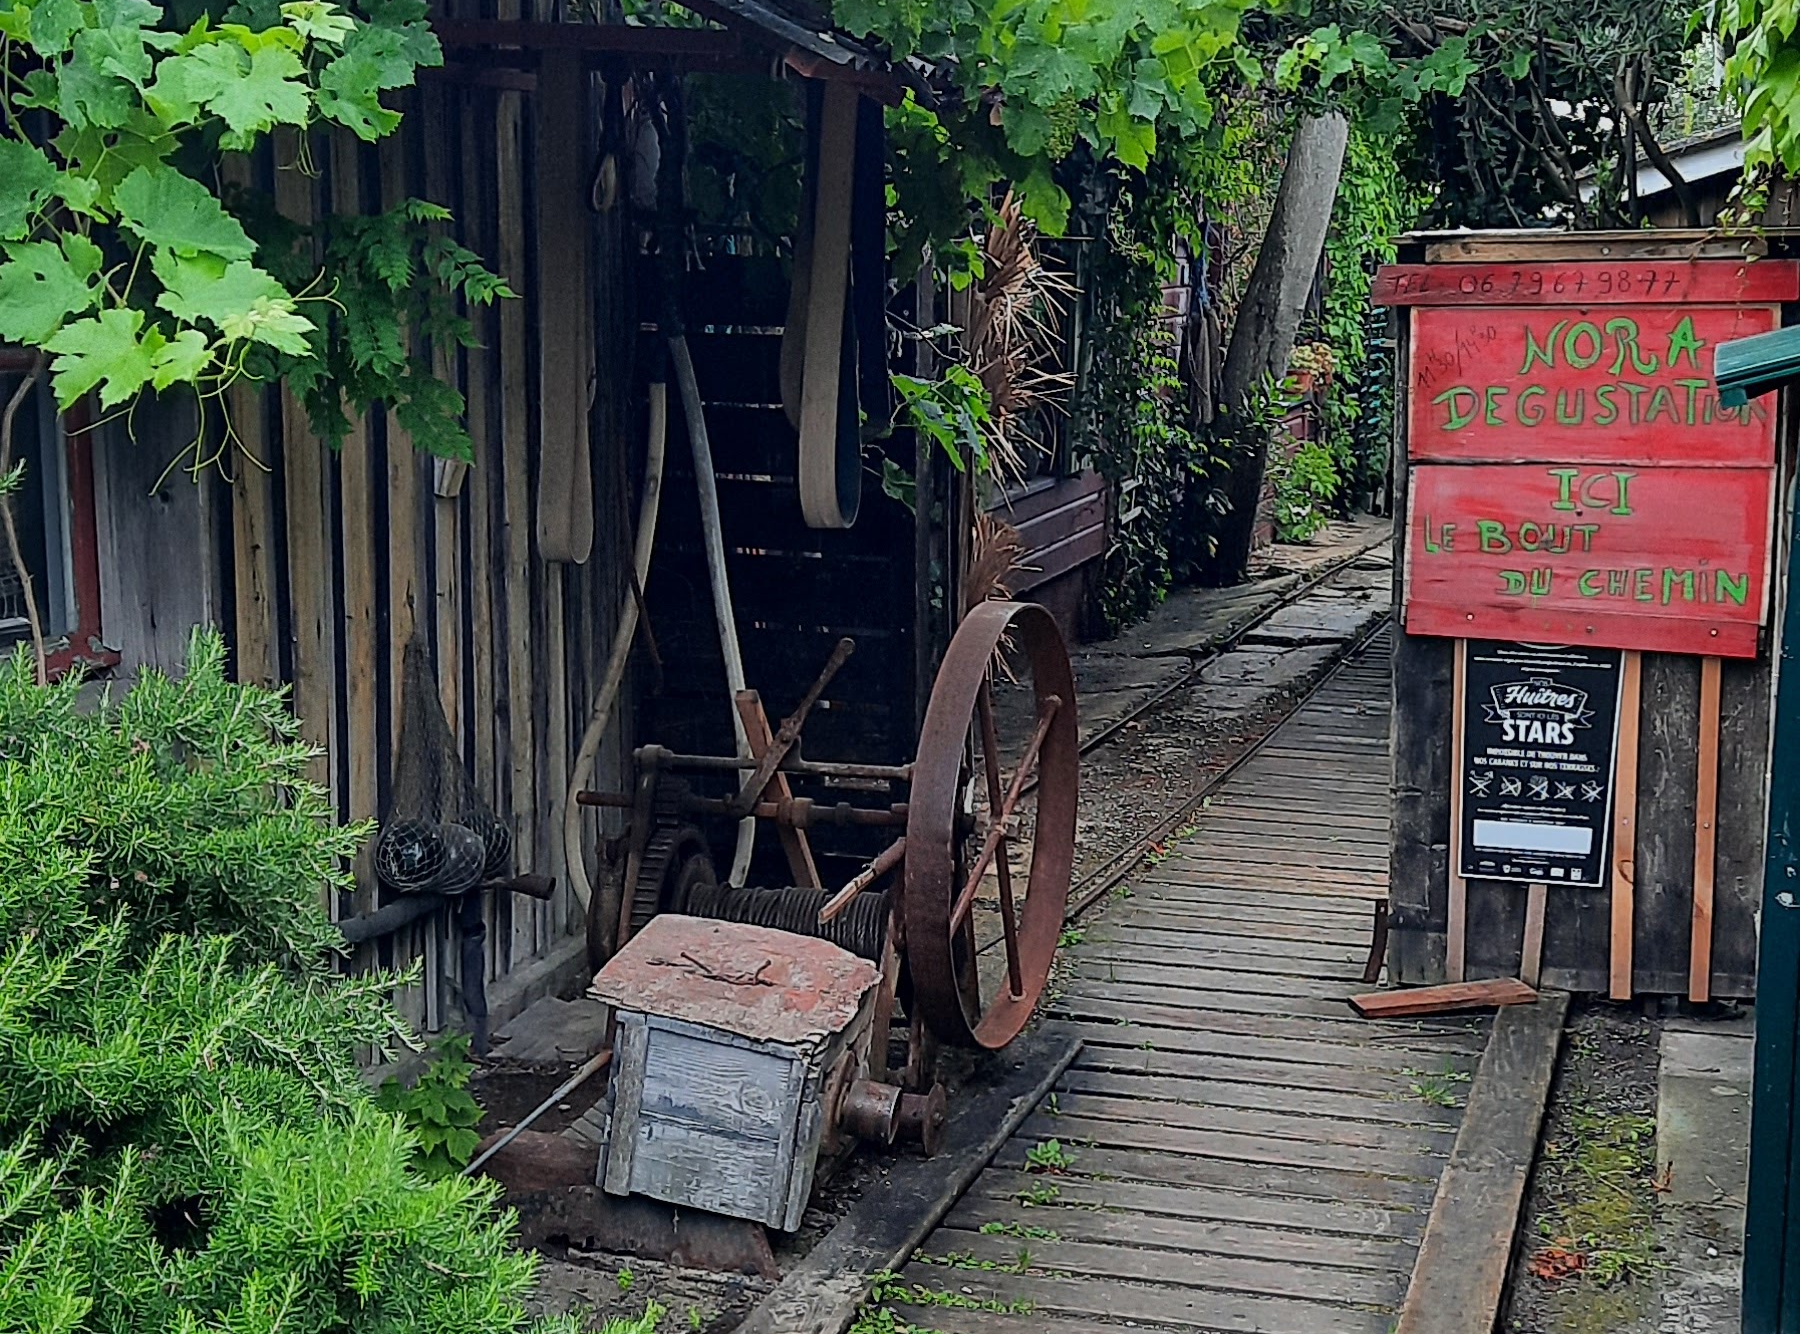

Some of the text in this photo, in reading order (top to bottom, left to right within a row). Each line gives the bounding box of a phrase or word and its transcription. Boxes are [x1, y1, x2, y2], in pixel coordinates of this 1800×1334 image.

[1459, 272, 1494, 295] 06
[1518, 315, 1707, 378] NORA
[1547, 467, 1639, 517] ICI
[1423, 513, 1601, 556] LE BOUT
[1495, 558, 1750, 607] DU CHEMIN
[1504, 685, 1578, 709] Huîtres
[1502, 718, 1575, 746] STARS
